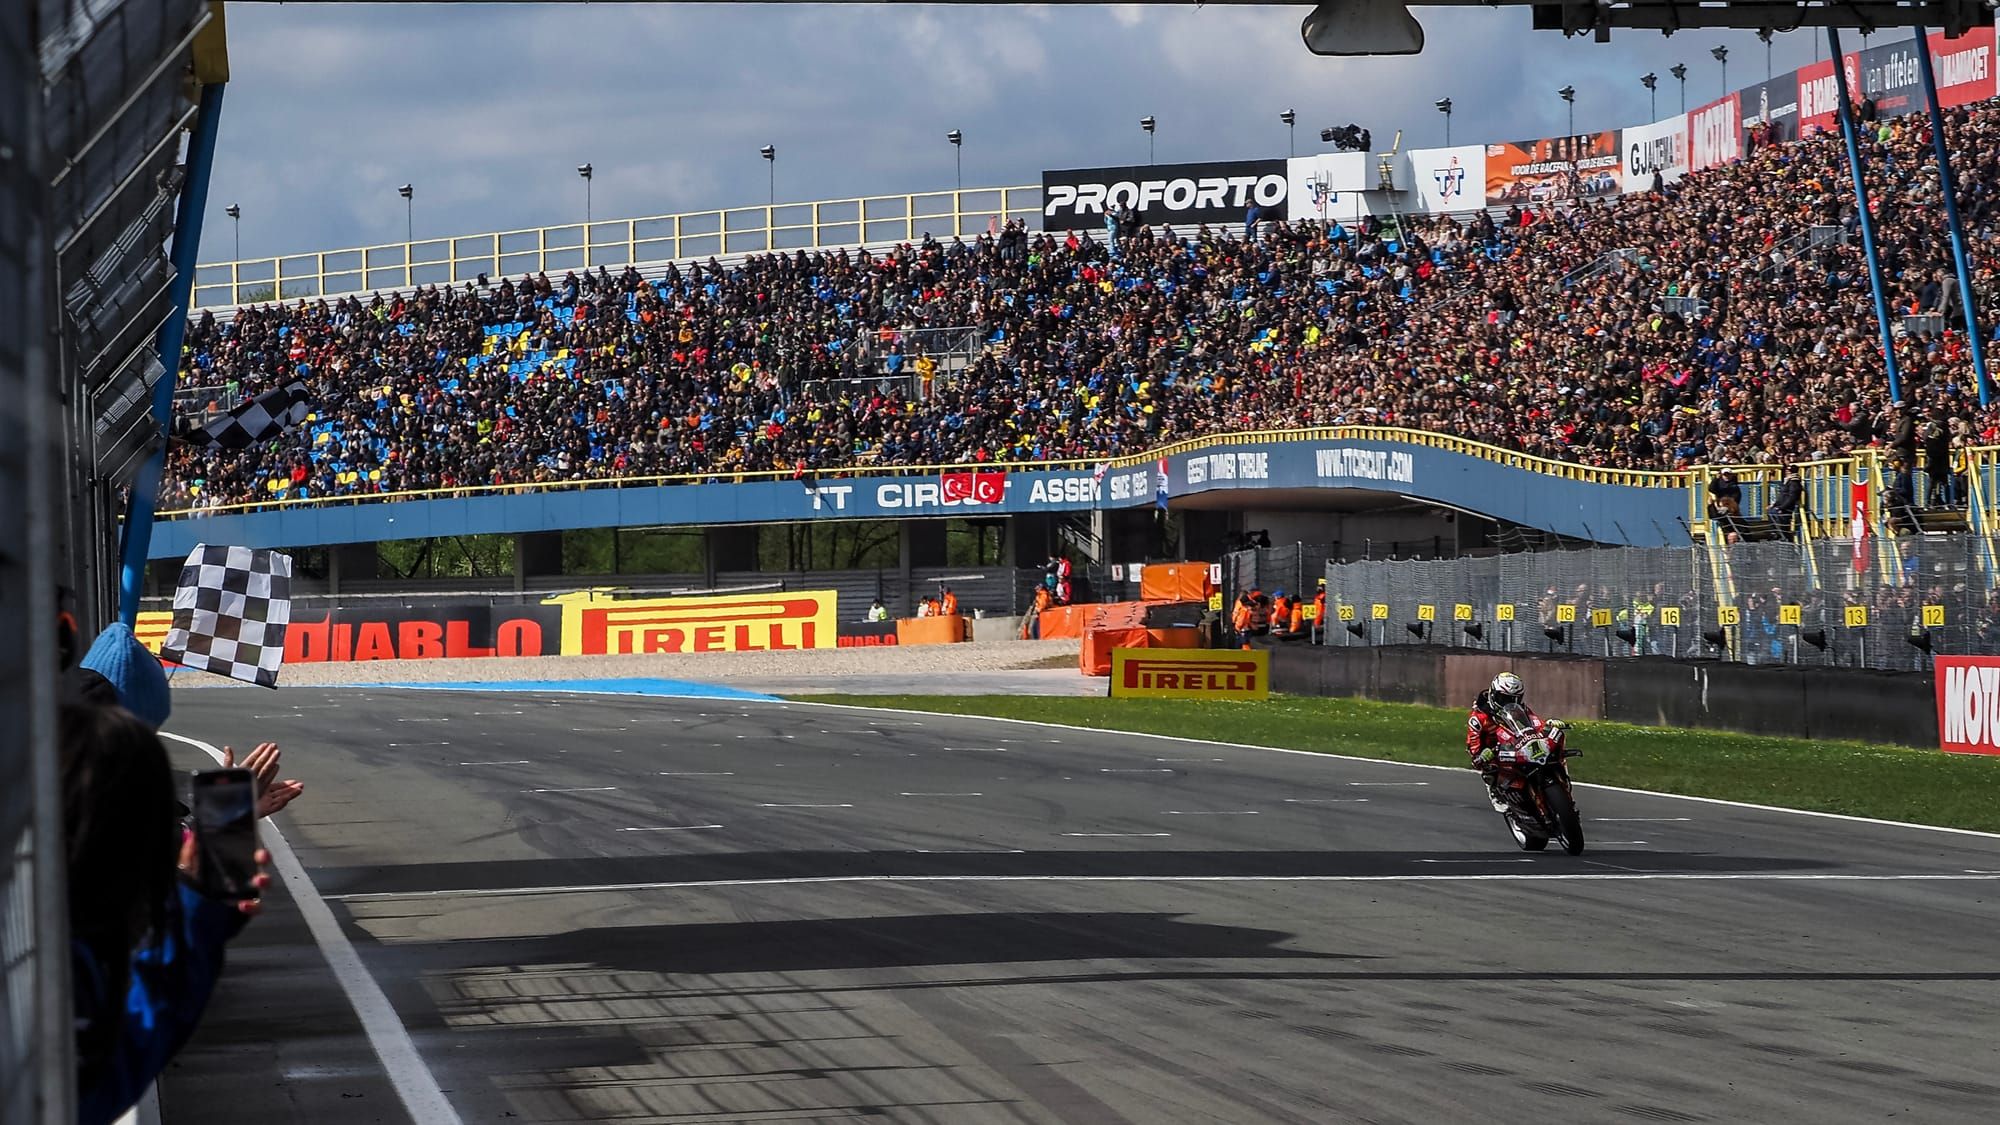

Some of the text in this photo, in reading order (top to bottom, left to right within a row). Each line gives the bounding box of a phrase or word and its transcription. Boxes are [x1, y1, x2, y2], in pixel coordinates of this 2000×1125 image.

[1942, 46, 1989, 87] MAMMOET
[1692, 100, 1737, 171] MOTUL
[1045, 174, 1288, 216] PROFORTO
[806, 486, 852, 510] TT
[1029, 478, 1102, 504] ASSEN
[1210, 597, 1220, 609] 25
[1304, 606, 1316, 618] 24
[1340, 608, 1353, 618] 23
[1374, 606, 1386, 618] 22
[1421, 608, 1433, 618] 21
[1456, 606, 1470, 618] 20
[1500, 606, 1512, 618] 19
[1559, 606, 1572, 620] 18
[1595, 611, 1608, 624] 17
[1664, 609, 1678, 624] 16
[1721, 610, 1735, 624] 15
[1784, 608, 1798, 623] 14
[1848, 609, 1864, 624] 13
[1926, 608, 1943, 624] 12
[582, 599, 818, 655] PIRELLI
[284, 612, 542, 663] DIABLO
[838, 634, 896, 647] DIABLO
[1124, 660, 1257, 690] PIRELLI
